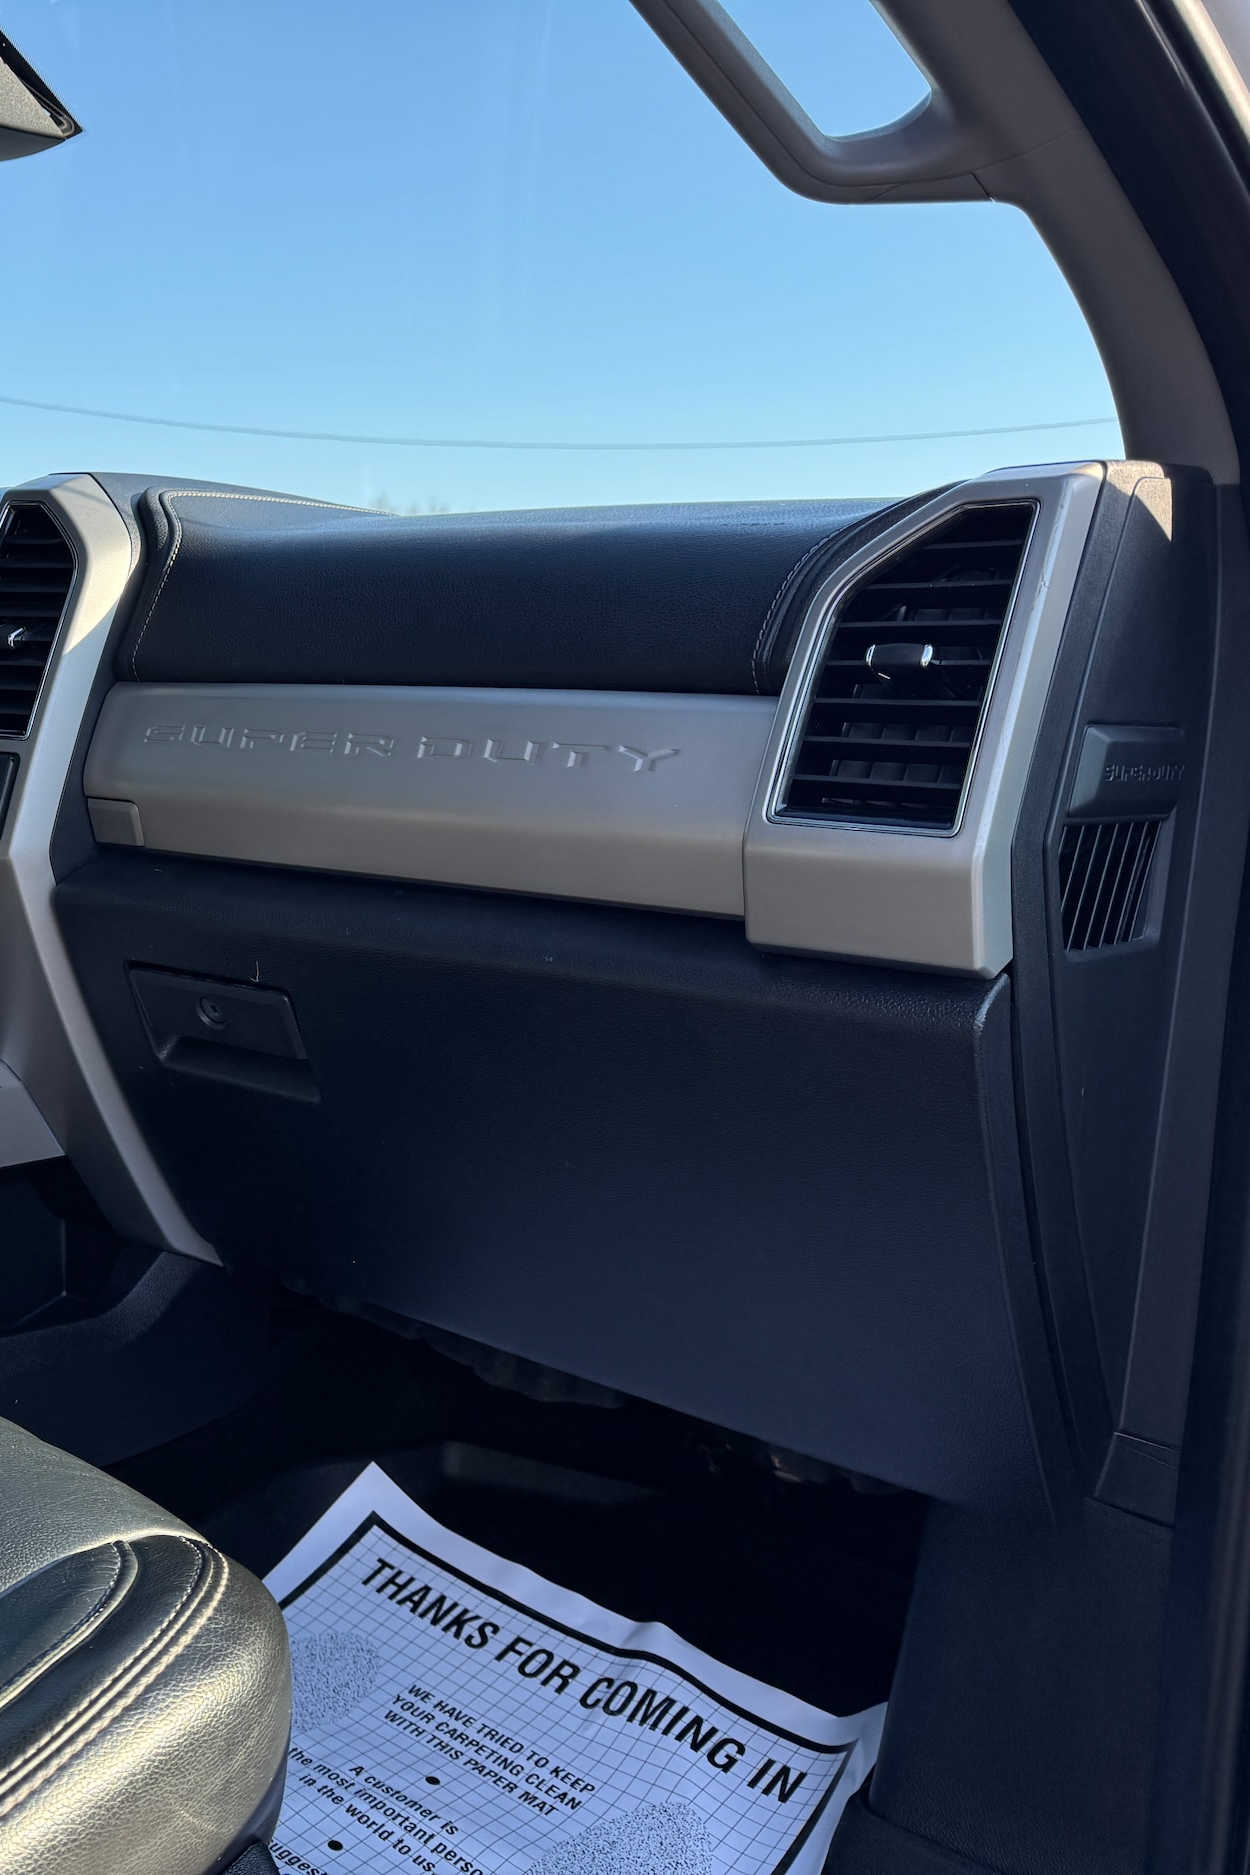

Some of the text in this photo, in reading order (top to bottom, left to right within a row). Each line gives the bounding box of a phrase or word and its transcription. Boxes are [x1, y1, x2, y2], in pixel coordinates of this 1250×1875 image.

[143, 723, 681, 772] SUPER DUTY
[359, 1557, 808, 1804] THANKS FOR COMING IN
[383, 1709, 560, 1817] WITH THIS PAPER MAT
[392, 1694, 584, 1811] YOUR CARPETING CLEAN
[408, 1684, 596, 1795] WE HAVE TRIED TO KEEP
[289, 1747, 313, 1766] the
[313, 1763, 356, 1791] most
[354, 1787, 435, 1845] important
[299, 1773, 317, 1787] in
[317, 1785, 345, 1805] the
[345, 1803, 396, 1842] world
[392, 1838, 412, 1856] to
[348, 1765, 459, 1836] A customer is
